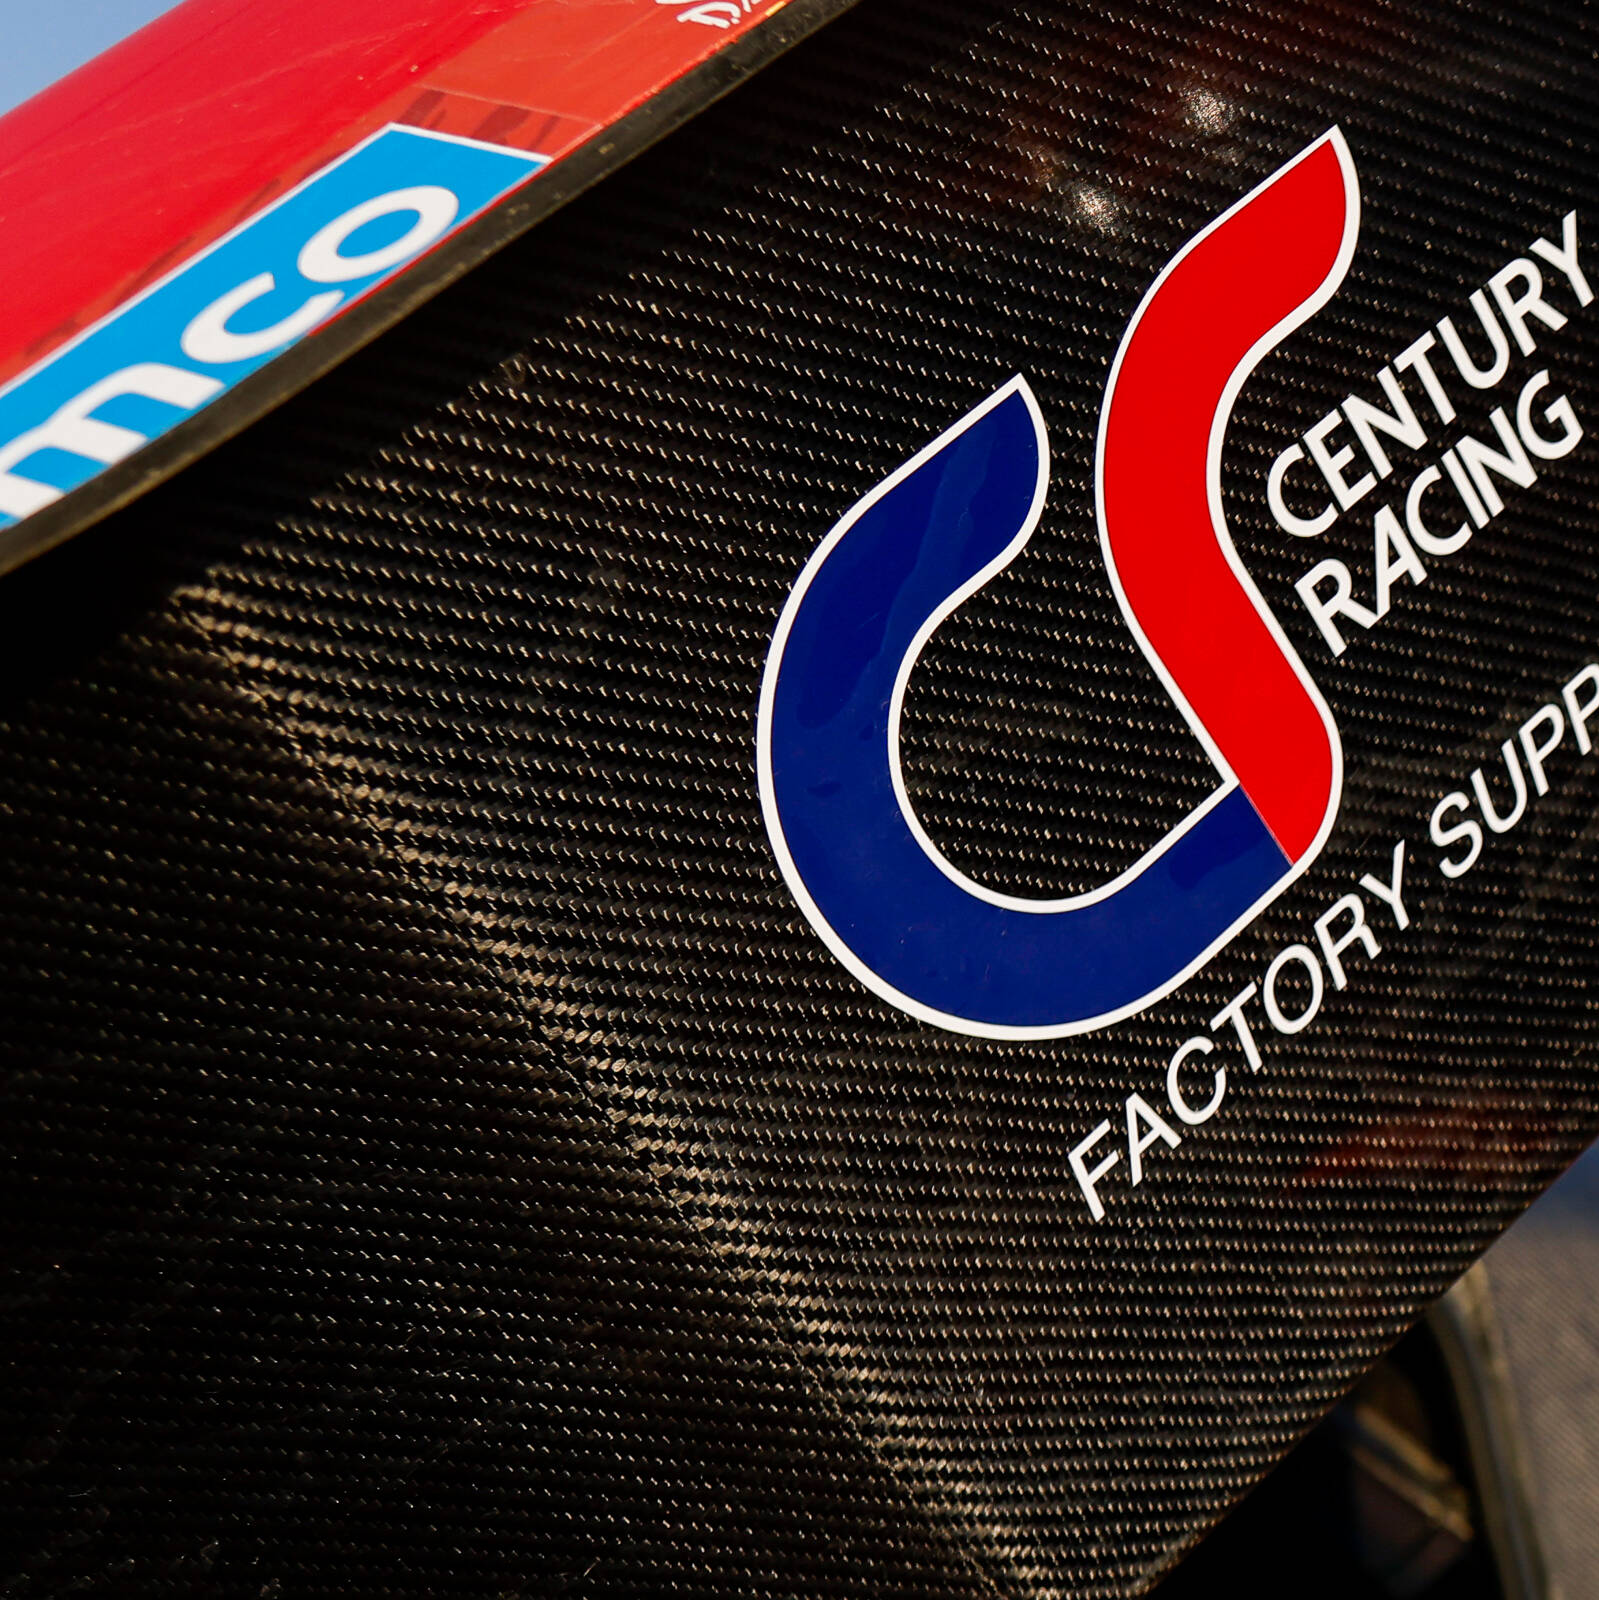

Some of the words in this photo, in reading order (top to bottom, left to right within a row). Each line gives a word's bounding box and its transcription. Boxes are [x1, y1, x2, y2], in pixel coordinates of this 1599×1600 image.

[1267, 211, 1596, 538] CENTURY
[1295, 370, 1584, 657] RACING
[1067, 842, 1409, 1223] FACTORY
